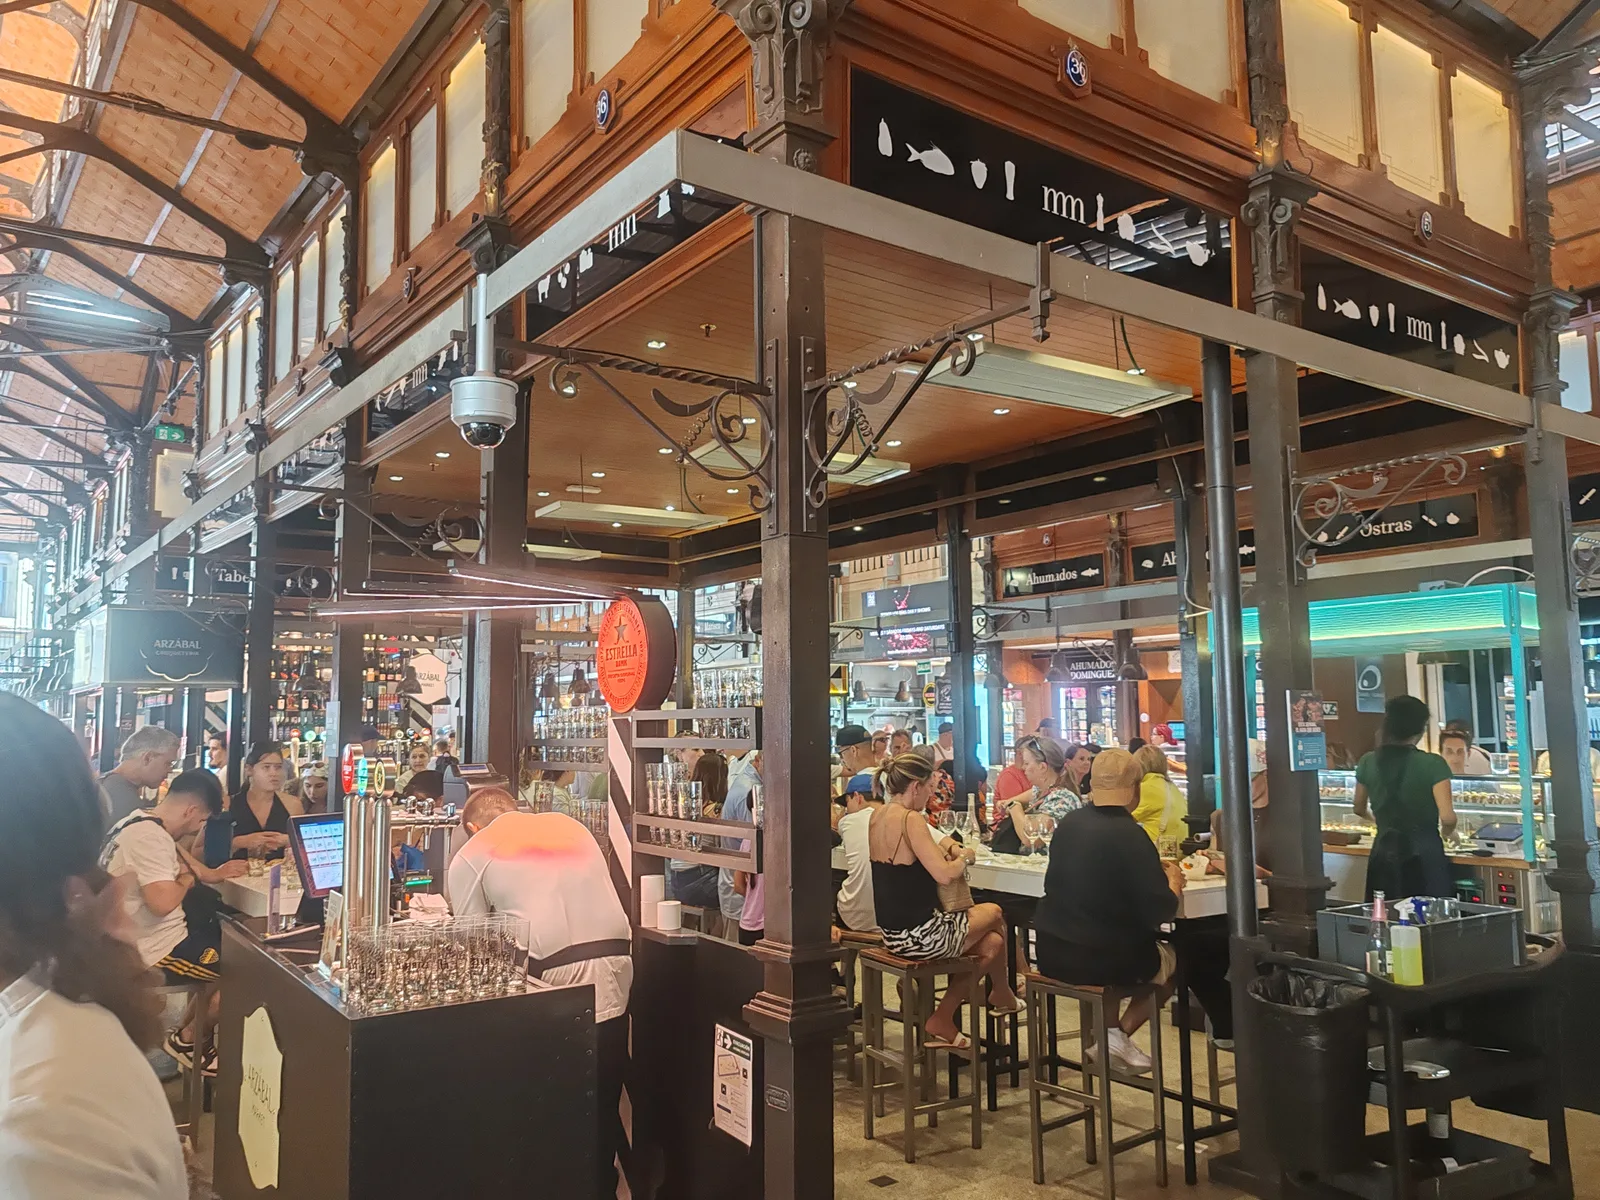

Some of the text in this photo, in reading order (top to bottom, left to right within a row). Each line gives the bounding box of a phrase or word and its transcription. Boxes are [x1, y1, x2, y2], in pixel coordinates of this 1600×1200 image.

[1071, 57, 1086, 78] 36
[1025, 567, 1078, 586] Ahumados
[154, 637, 201, 650] ARZÁBAL
[605, 644, 638, 661] ESTRELLA
[1070, 660, 1116, 671] AHUMADO
